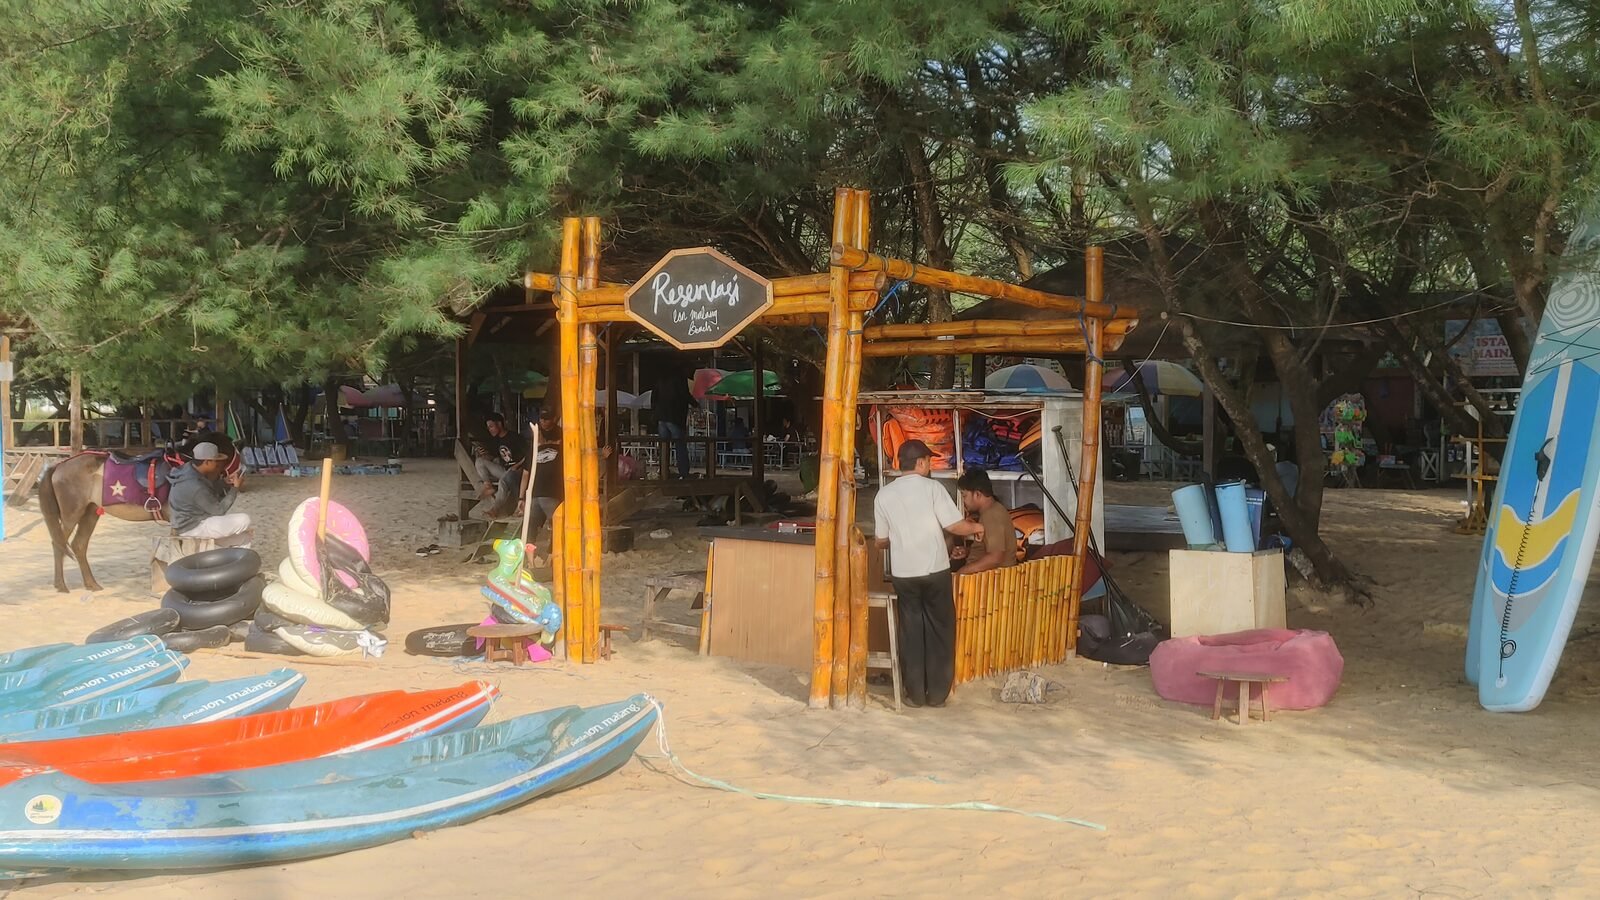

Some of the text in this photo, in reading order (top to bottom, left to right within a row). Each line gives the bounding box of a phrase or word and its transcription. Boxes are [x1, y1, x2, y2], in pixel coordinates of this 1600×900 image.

[1473, 348, 1512, 358] MAIN
[87, 642, 136, 661] malang
[108, 660, 160, 680] malang
[225, 679, 277, 701] malang
[421, 690, 469, 712] malang
[601, 703, 641, 727] malang
